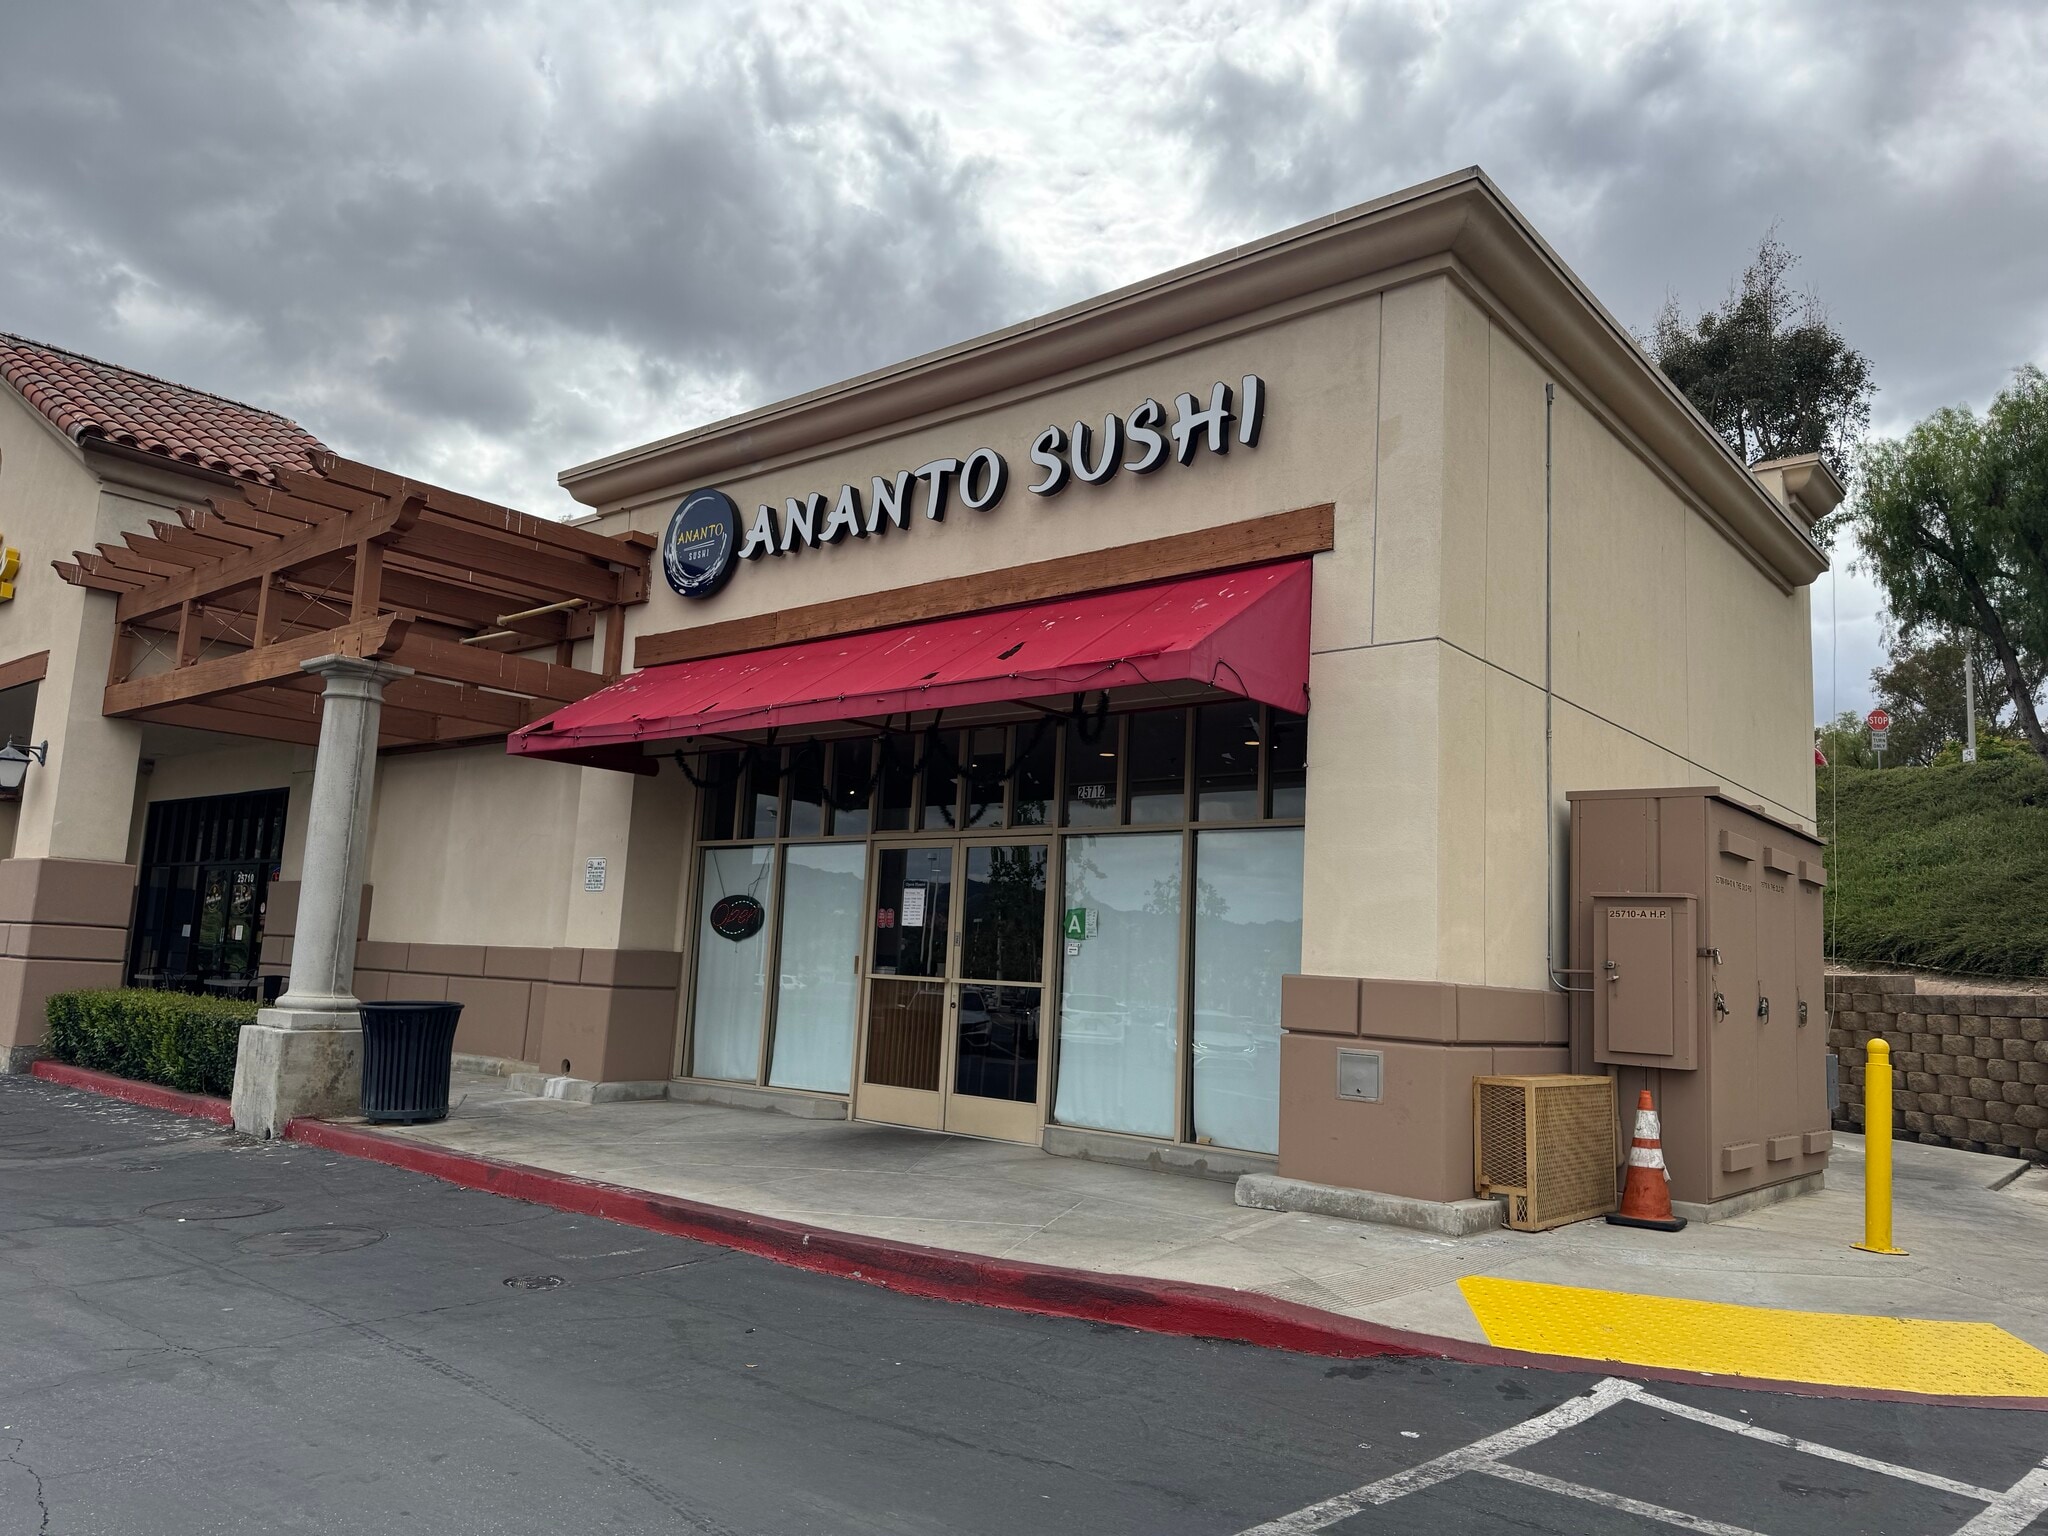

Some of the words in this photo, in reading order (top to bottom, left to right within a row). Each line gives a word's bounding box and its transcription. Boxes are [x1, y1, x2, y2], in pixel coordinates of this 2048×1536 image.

[738, 446, 1009, 560] ANANTO
[1027, 373, 1266, 498] SUSHI
[677, 522, 724, 545] ANANTO
[688, 548, 710, 561] SUSHI
[1869, 716, 1888, 725] STOP
[1078, 785, 1105, 799] 25712
[237, 873, 255, 883] 25710
[1609, 910, 1647, 918] 25710-A
[1649, 910, 1666, 919] H.P.
[1068, 915, 1081, 933] A
